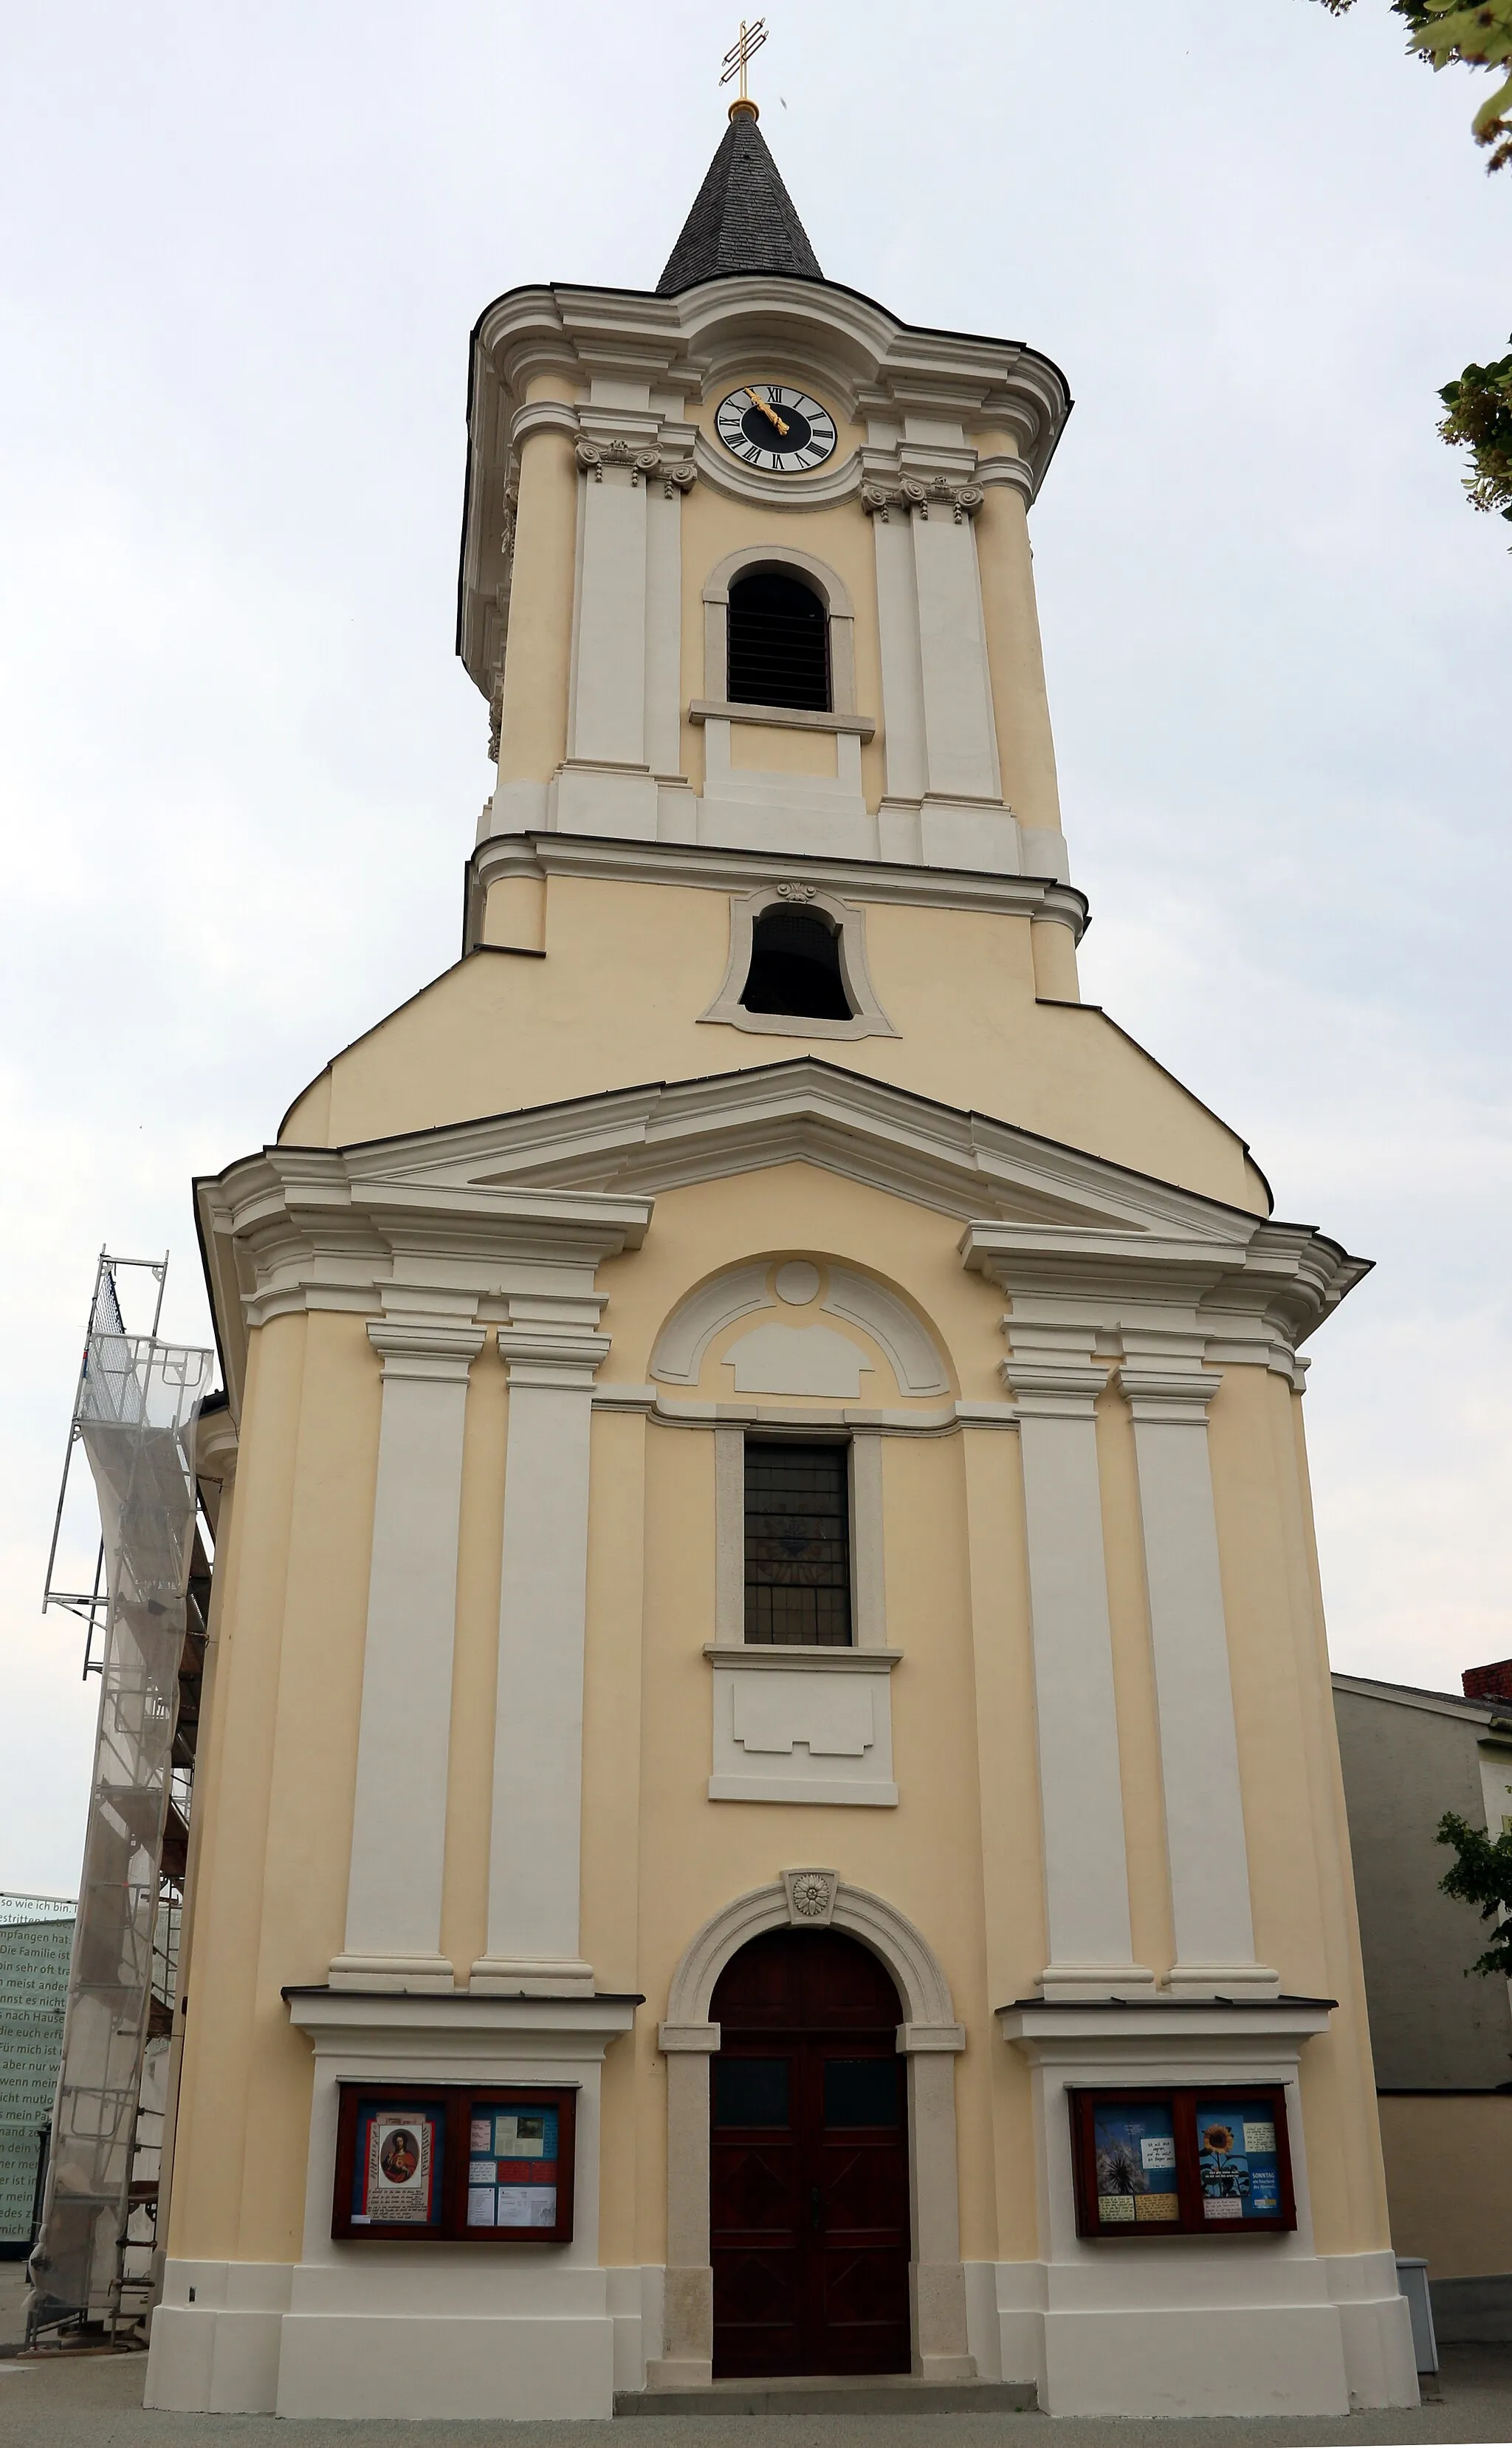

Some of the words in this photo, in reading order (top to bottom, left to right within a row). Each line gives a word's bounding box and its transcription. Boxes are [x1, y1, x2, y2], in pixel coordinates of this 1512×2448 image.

[767, 386, 783, 403] XII
[725, 399, 747, 414] X
[807, 411, 827, 421] II
[812, 429, 833, 439] III
[772, 453, 785, 470] VI
[794, 452, 811, 468] V
[1, 1899, 13, 1907] so
[16, 1898, 33, 1909] wie
[36, 1899, 50, 1911] ich
[53, 1902, 72, 1913] bin.
[52, 1933, 72, 1944] hat.
[0, 1945, 16, 1955] Die
[19, 1947, 55, 1958] Familie
[58, 1950, 71, 1960] ist
[16, 1963, 38, 1972] sehr
[40, 1964, 55, 1975] oft
[7, 1979, 35, 1989] meist
[6, 2012, 30, 2020] nach
[33, 2012, 64, 2023] Hause
[16, 2028, 41, 2038] euch
[17, 2044, 41, 2054] mich
[44, 2046, 57, 2055] ist
[3, 2059, 27, 2070] aber
[29, 2063, 47, 2071] nur
[6, 2111, 32, 2120] mein
[8, 2143, 31, 2153] dein
[13, 2176, 25, 2185] ist
